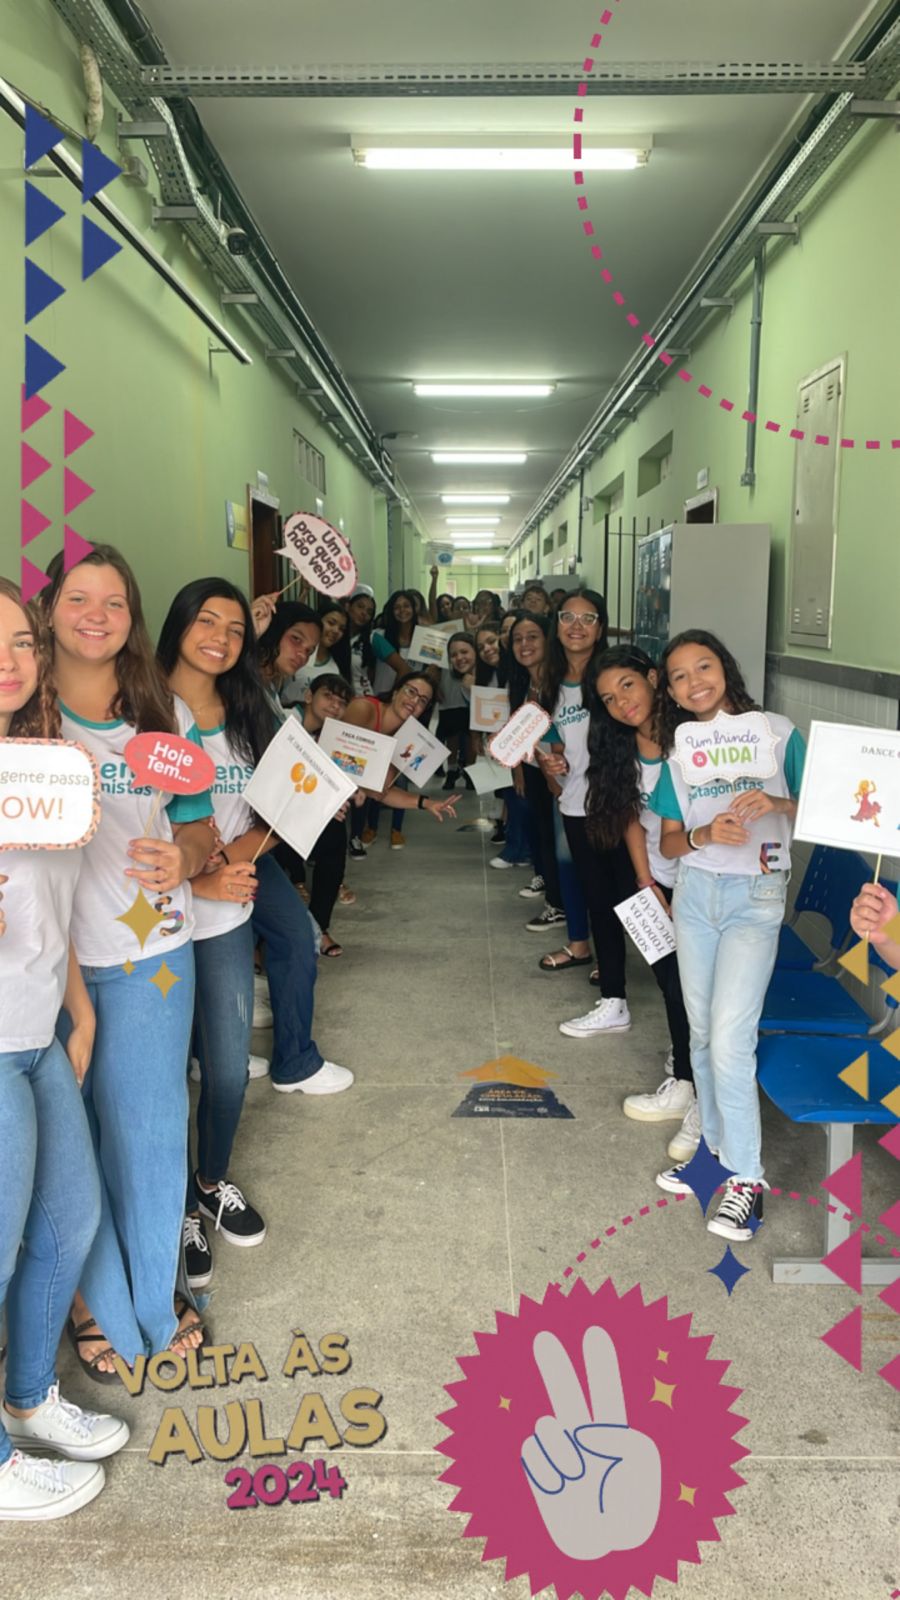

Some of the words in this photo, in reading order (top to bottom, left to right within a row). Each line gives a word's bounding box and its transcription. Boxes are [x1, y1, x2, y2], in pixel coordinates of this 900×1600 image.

[293, 520, 318, 545] pra
[315, 546, 344, 582] quem
[322, 530, 341, 556] Um
[287, 531, 309, 556] não
[308, 557, 336, 589] veio!
[511, 714, 544, 748] SUCESSO
[685, 735, 713, 750] Um
[714, 728, 760, 745] brinde
[154, 741, 194, 767] Hoje
[708, 746, 758, 766] VIDA!
[861, 746, 896, 758] DANCE
[0, 770, 46, 785] gente
[48, 774, 90, 786] passa
[148, 755, 190, 783] Tem...
[630, 902, 644, 918] DA
[624, 916, 650, 952] SOMOS
[640, 918, 666, 954] TODOS
